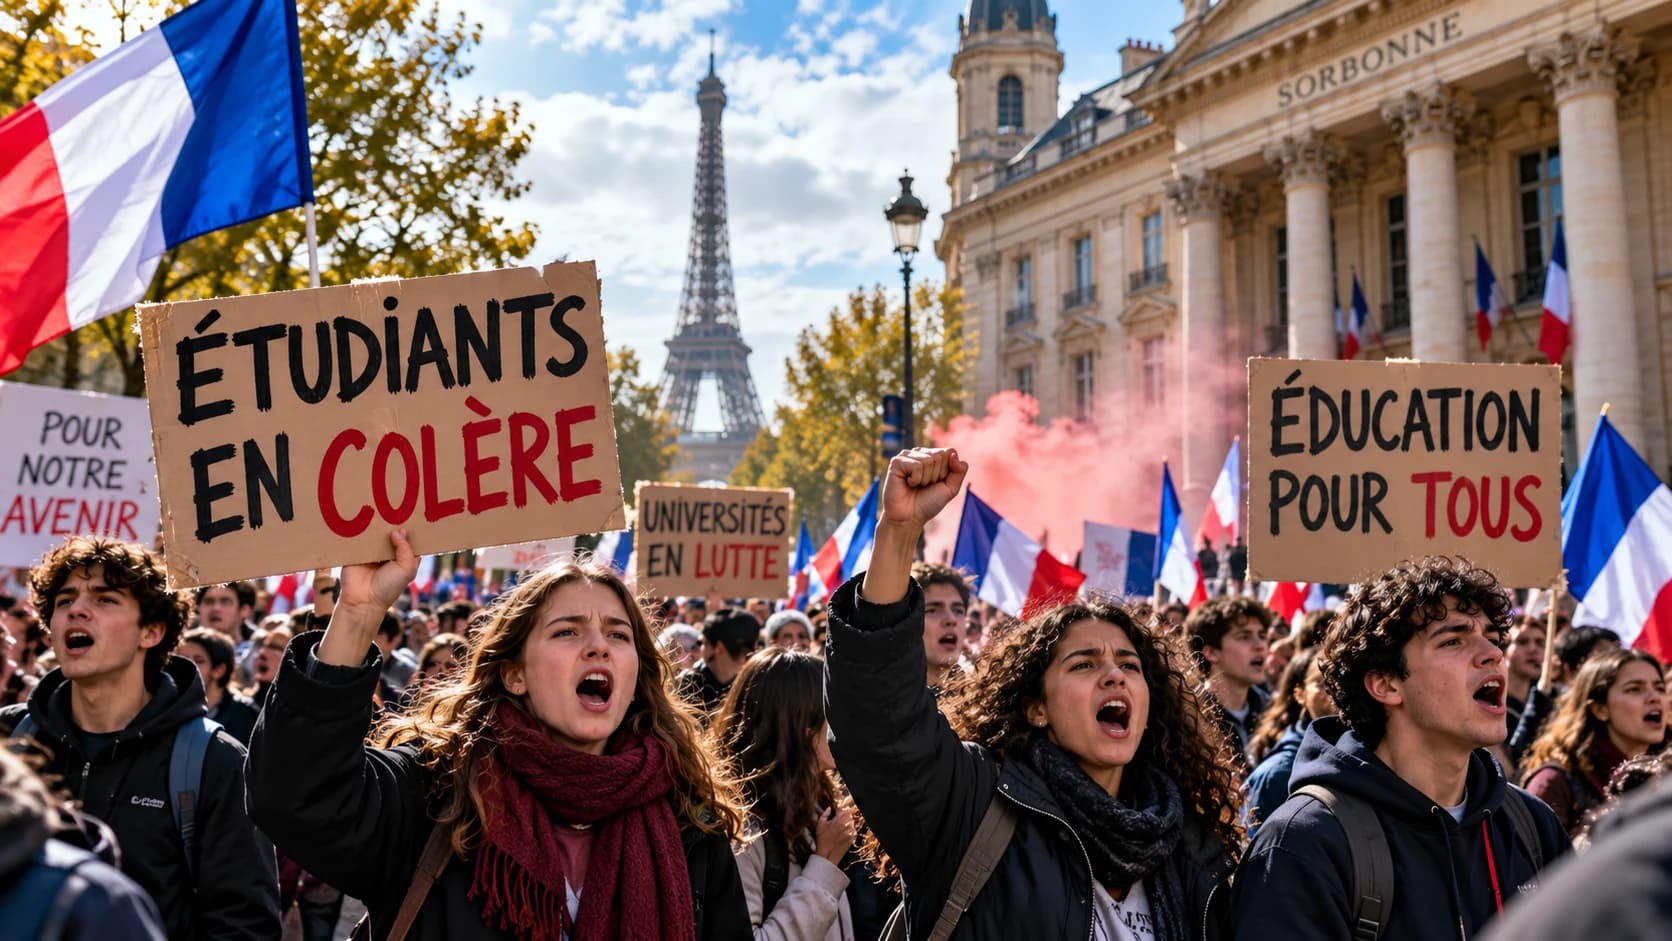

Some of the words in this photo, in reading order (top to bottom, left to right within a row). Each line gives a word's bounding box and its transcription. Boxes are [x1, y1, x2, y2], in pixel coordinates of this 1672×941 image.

[1278, 11, 1463, 108] SORBONNE
[177, 292, 589, 427] ÉTUDIANTS
[40, 411, 122, 449] POUR
[1270, 369, 1540, 457] ÉDUCATION
[17, 454, 127, 490] NOTRE
[190, 432, 294, 544] EN
[318, 396, 602, 538] COLÈRE
[0, 494, 139, 541] AVENIR
[644, 497, 786, 536] UNIVERSITÉS
[1269, 470, 1393, 536] POUR
[1411, 471, 1543, 542] TOUS
[647, 542, 683, 578] EN
[694, 543, 781, 580] LUTTE
